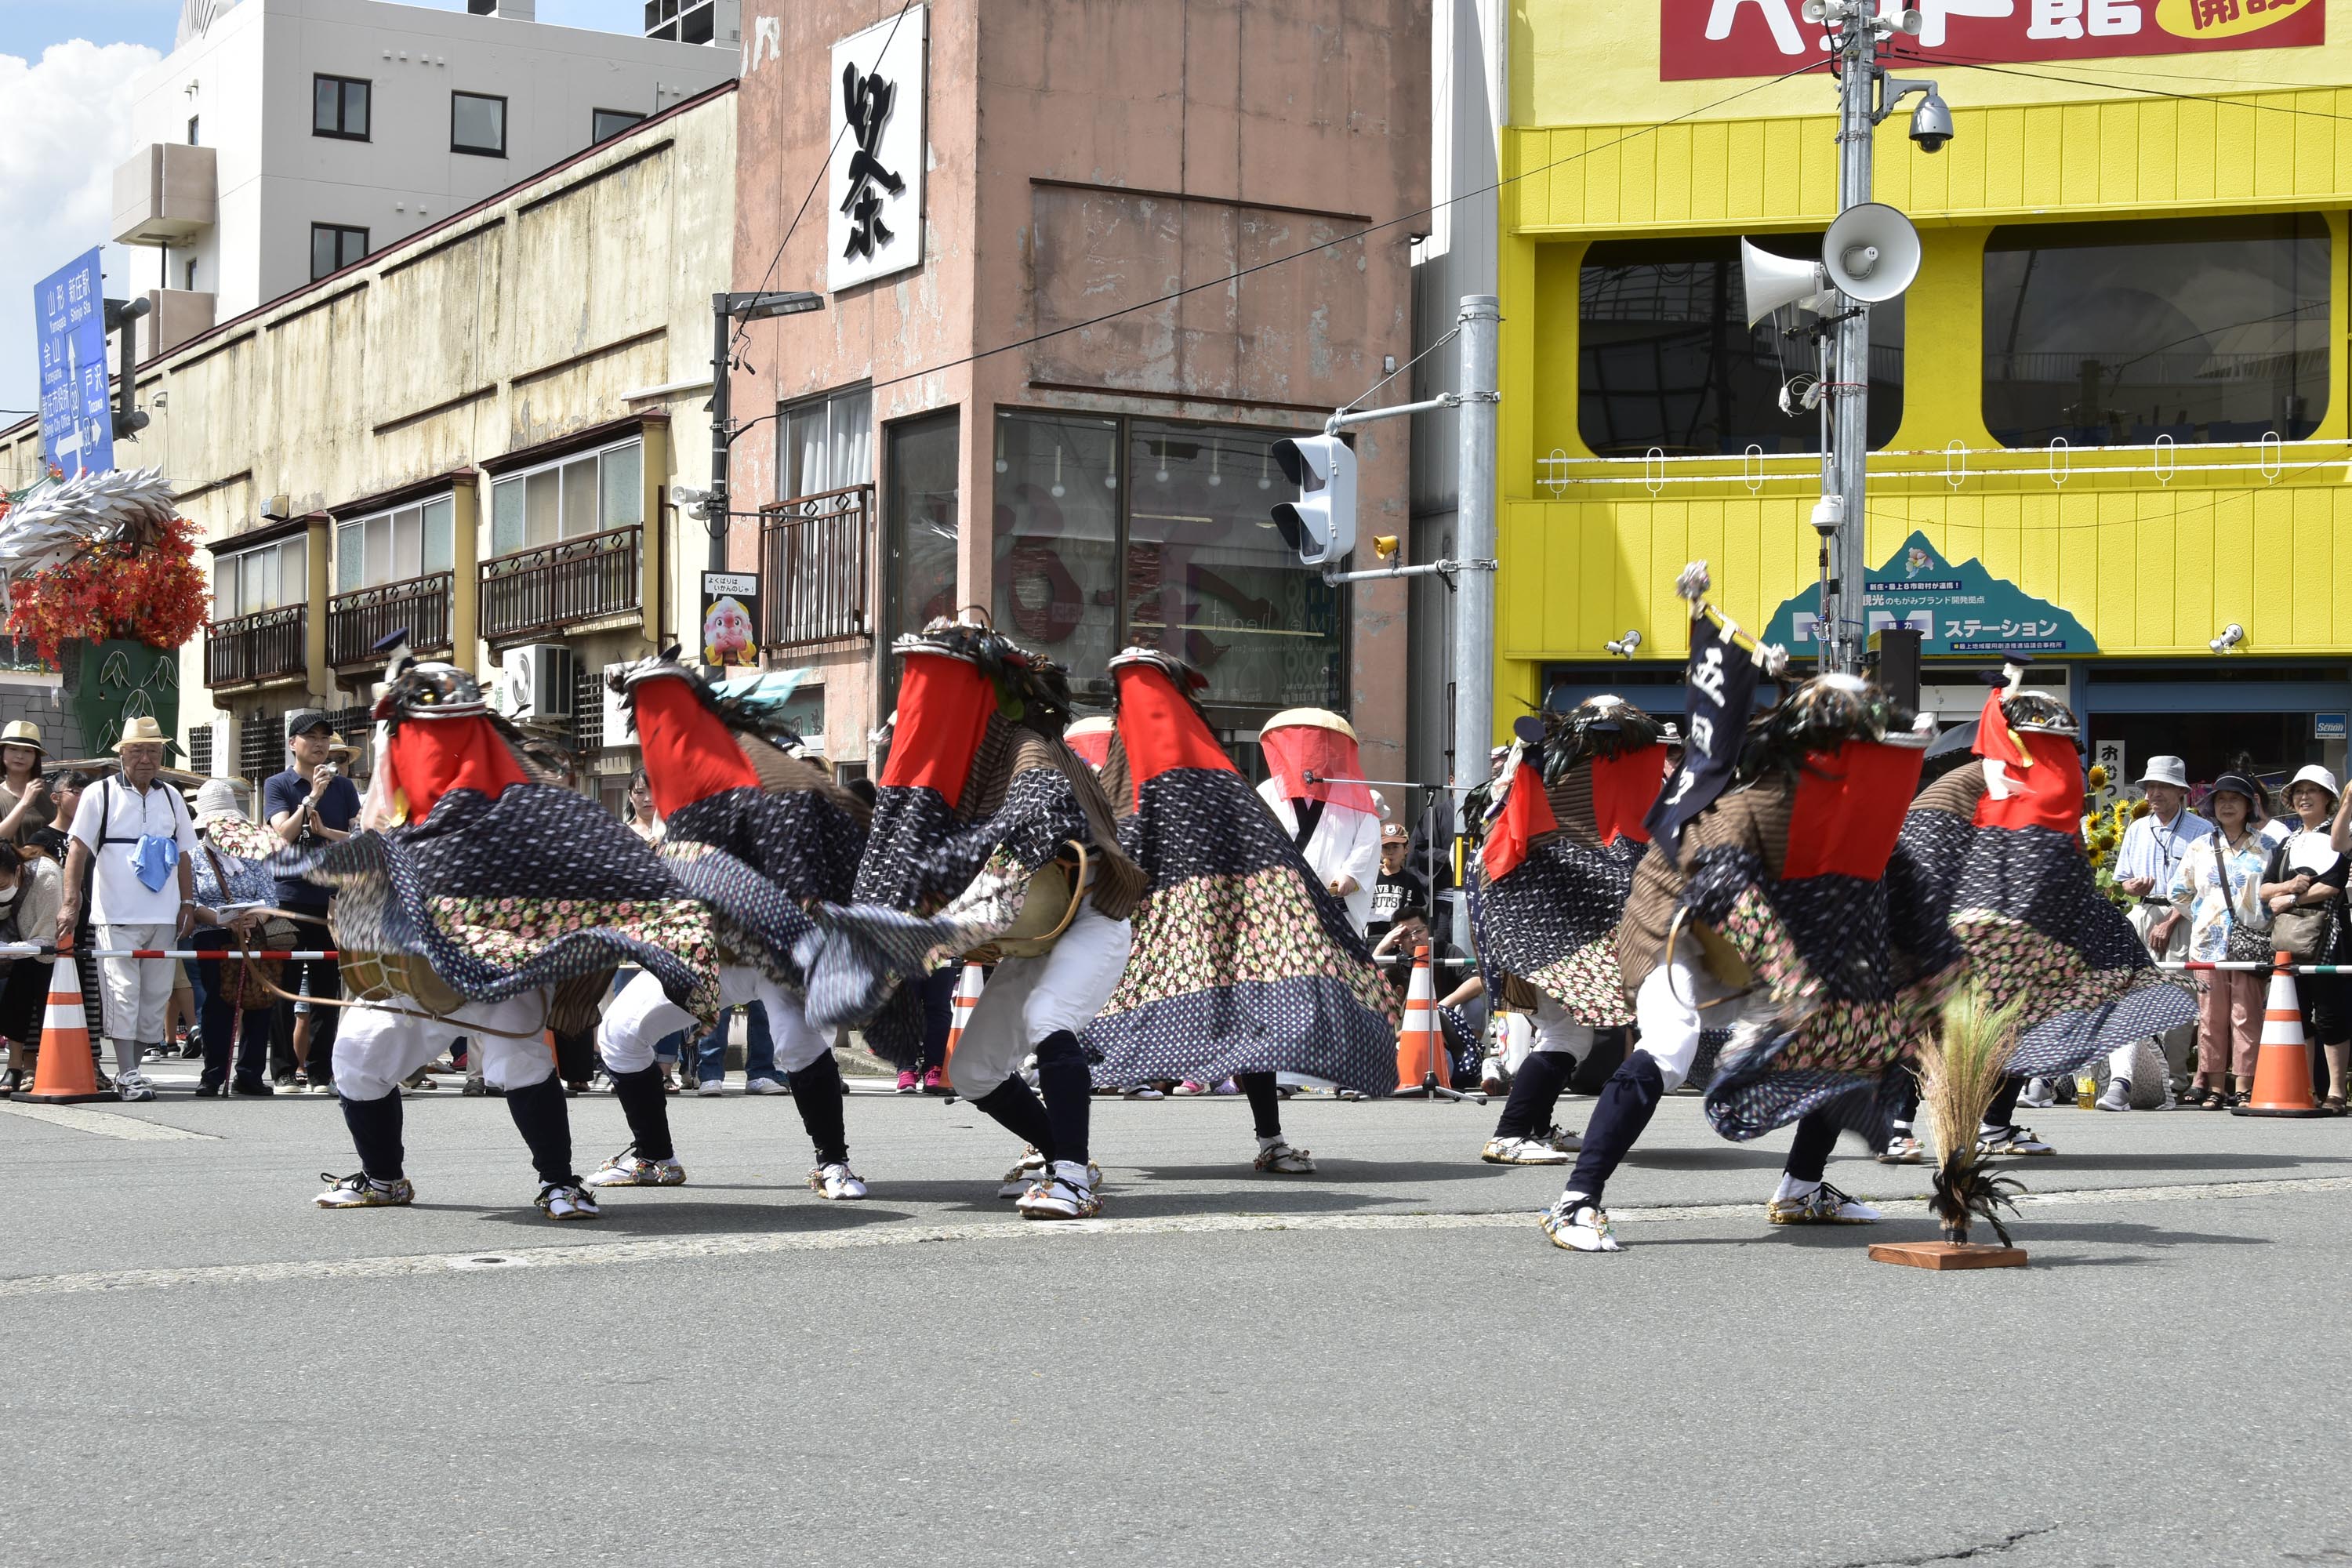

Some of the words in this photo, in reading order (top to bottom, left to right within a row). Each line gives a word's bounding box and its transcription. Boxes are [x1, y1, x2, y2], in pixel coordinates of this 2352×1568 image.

[48, 284, 64, 317] 山形
[68, 267, 91, 304] 新庄駅
[49, 314, 67, 334] Yamagata
[71, 304, 83, 323] Shinjo
[43, 337, 60, 368] 金山
[45, 367, 63, 386] Kaneyama
[85, 363, 103, 397] 戸沢
[42, 382, 70, 420] 新庄市役所
[88, 397, 103, 414] Tozawa
[44, 421, 54, 437] Shinjo
[60, 415, 71, 430] Office
[1944, 619, 2058, 638] ステーション
[1374, 884, 1389, 894] AVE
